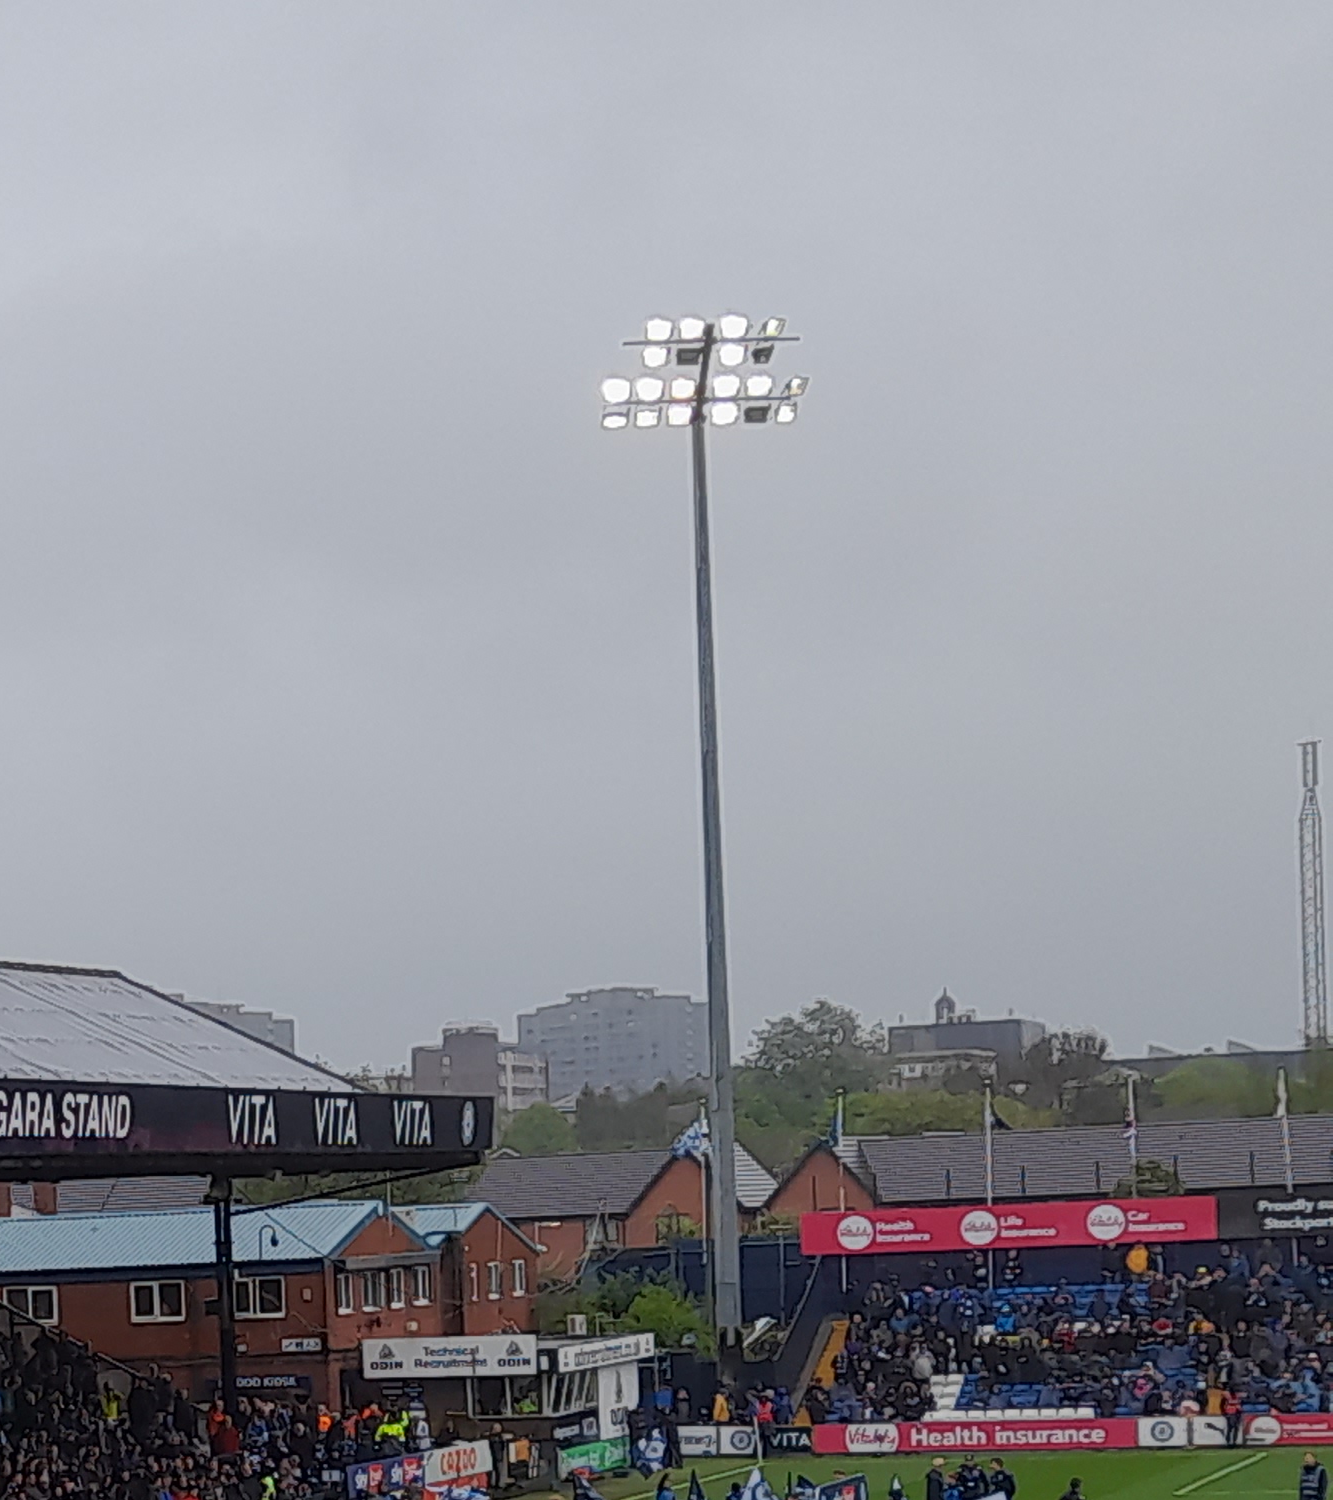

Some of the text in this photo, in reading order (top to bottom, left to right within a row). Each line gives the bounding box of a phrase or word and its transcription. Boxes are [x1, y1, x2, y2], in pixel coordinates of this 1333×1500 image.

[60, 1091, 132, 1139] STAND
[227, 1094, 279, 1146] VITA
[313, 1097, 358, 1146] VITA
[392, 1100, 433, 1146] VITA
[770, 1431, 811, 1448] VITA
[910, 1425, 1107, 1447] Health insurance
